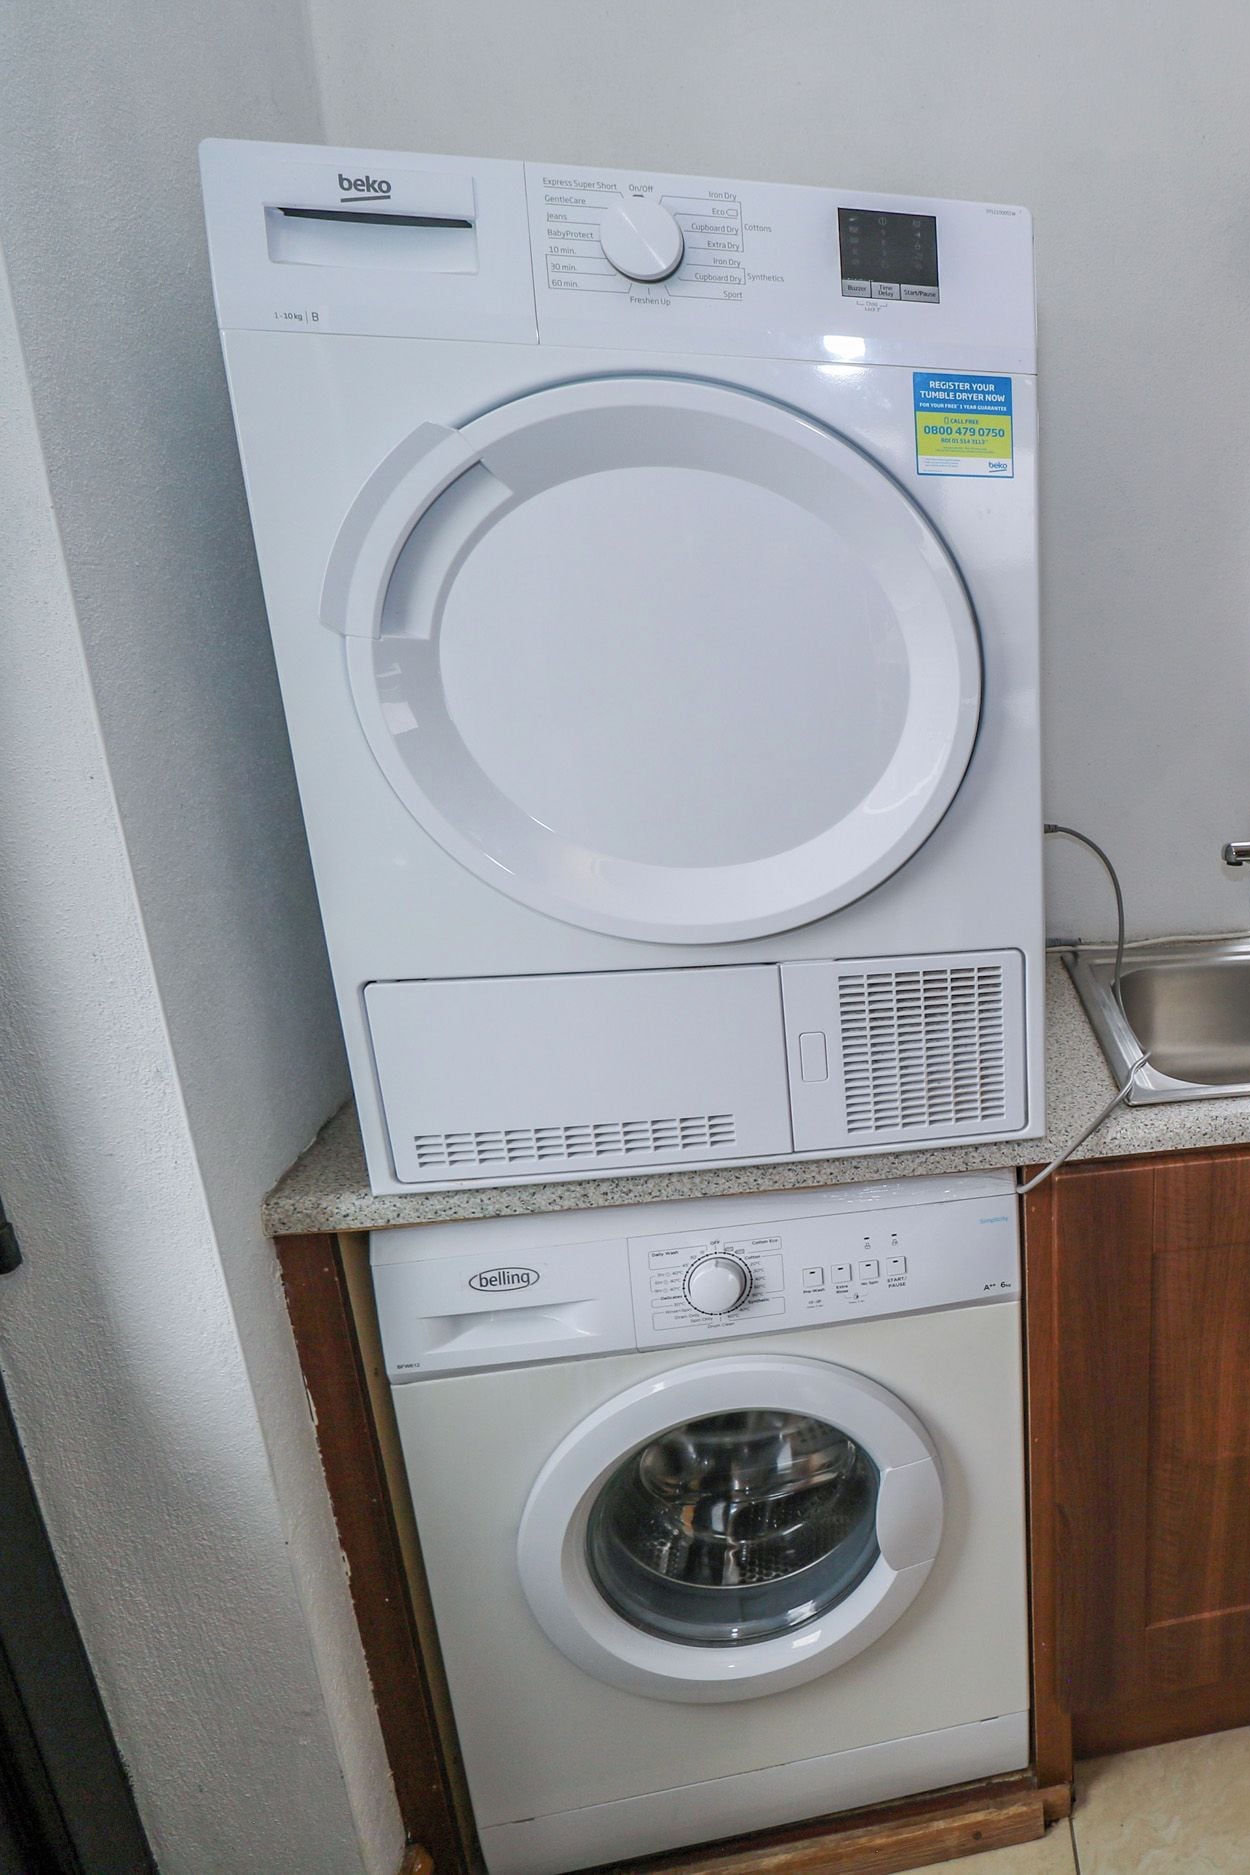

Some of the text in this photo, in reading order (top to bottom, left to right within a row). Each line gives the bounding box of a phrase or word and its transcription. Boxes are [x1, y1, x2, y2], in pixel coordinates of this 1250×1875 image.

[338, 173, 391, 194] beko
[542, 177, 617, 190] Express Super Short
[628, 183, 654, 193] On/Off
[544, 194, 586, 205] GentleCare
[708, 191, 737, 201] Iron Dry
[546, 212, 567, 221] Jeans
[711, 207, 725, 216] Eco
[691, 222, 739, 235] Cupboard Dry
[744, 223, 772, 233] Cottons
[547, 228, 594, 240] BabyProtect
[549, 246, 559, 254] 10
[707, 240, 740, 252] Extra Dry
[551, 262, 560, 271] 30
[713, 257, 741, 268] Iron Dry
[551, 279, 562, 287] 60
[694, 272, 741, 285] Cupboard Dry
[747, 272, 785, 283] Synthetics
[723, 290, 743, 300] Sport
[878, 290, 894, 298] Delay
[903, 289, 936, 298] Start/Pause
[629, 295, 671, 306] Freshen Up
[311, 311, 319, 322] B
[929, 380, 995, 392] REGISTER YOUR
[920, 390, 1005, 403] TUMBLE DRYER NOW
[923, 425, 1005, 438] 0800 479 0750
[988, 461, 1008, 470] beko
[478, 1269, 531, 1288] belling
